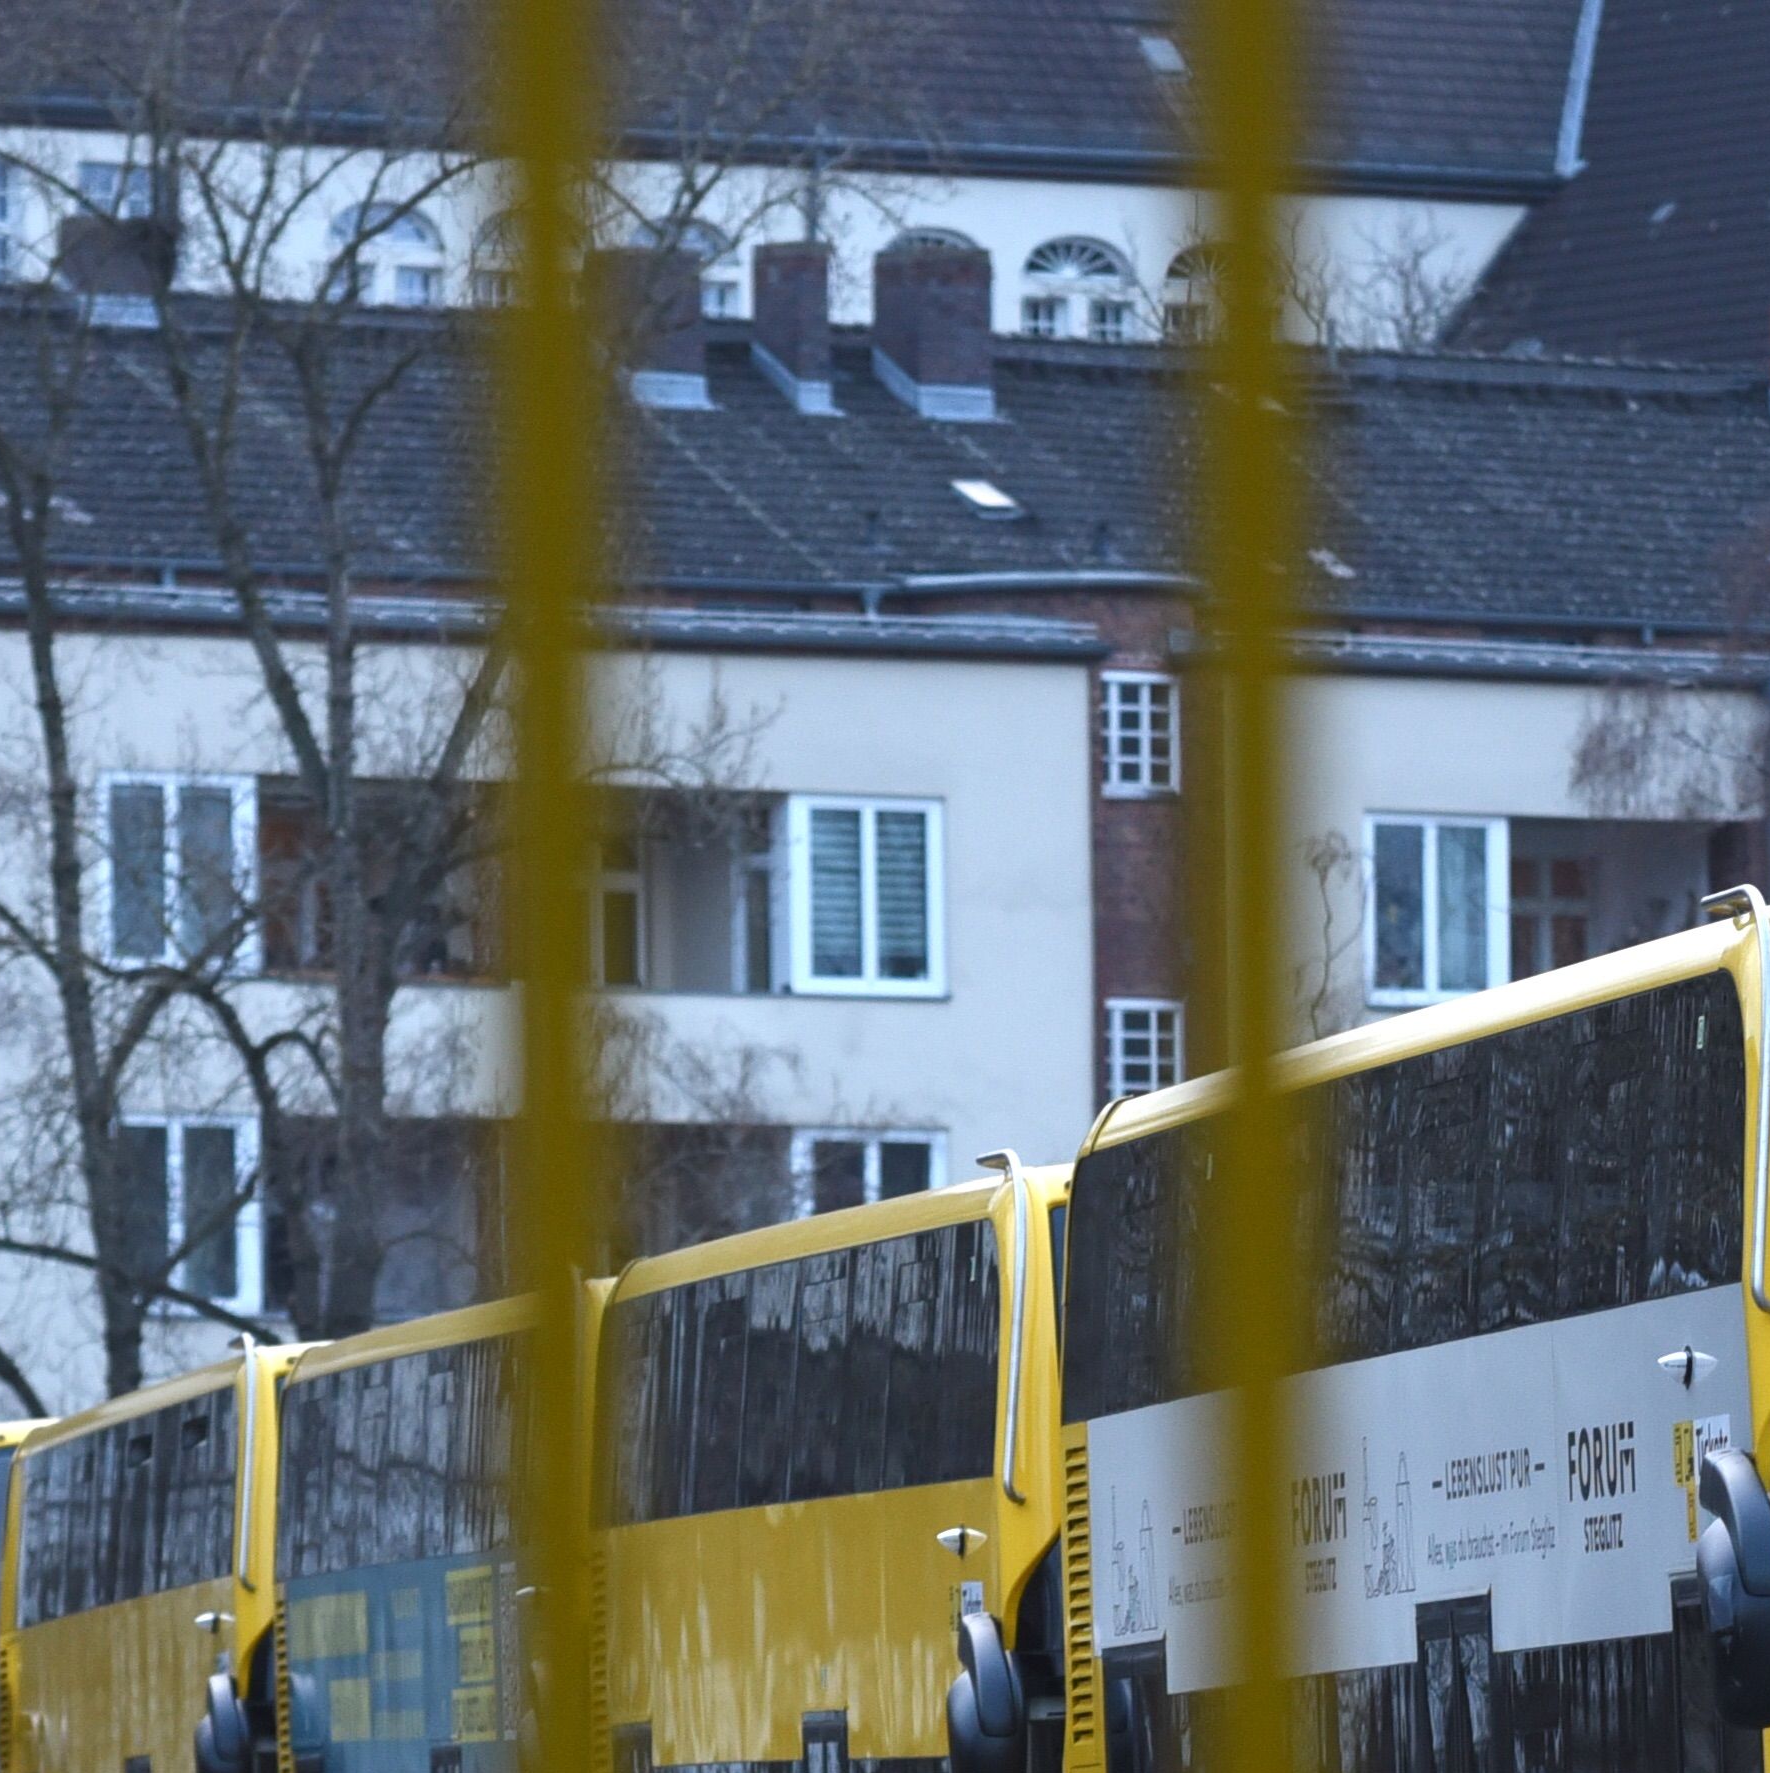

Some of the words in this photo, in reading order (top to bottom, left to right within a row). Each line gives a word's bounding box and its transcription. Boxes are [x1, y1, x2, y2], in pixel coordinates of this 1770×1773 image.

[1445, 1450, 1507, 1500] LEBENSLUST
[1510, 1447, 1531, 1489] PUR
[1568, 1421, 1636, 1501] FORUM
[1291, 1472, 1347, 1545] FORUM
[1584, 1513, 1623, 1553] STEGLITZ
